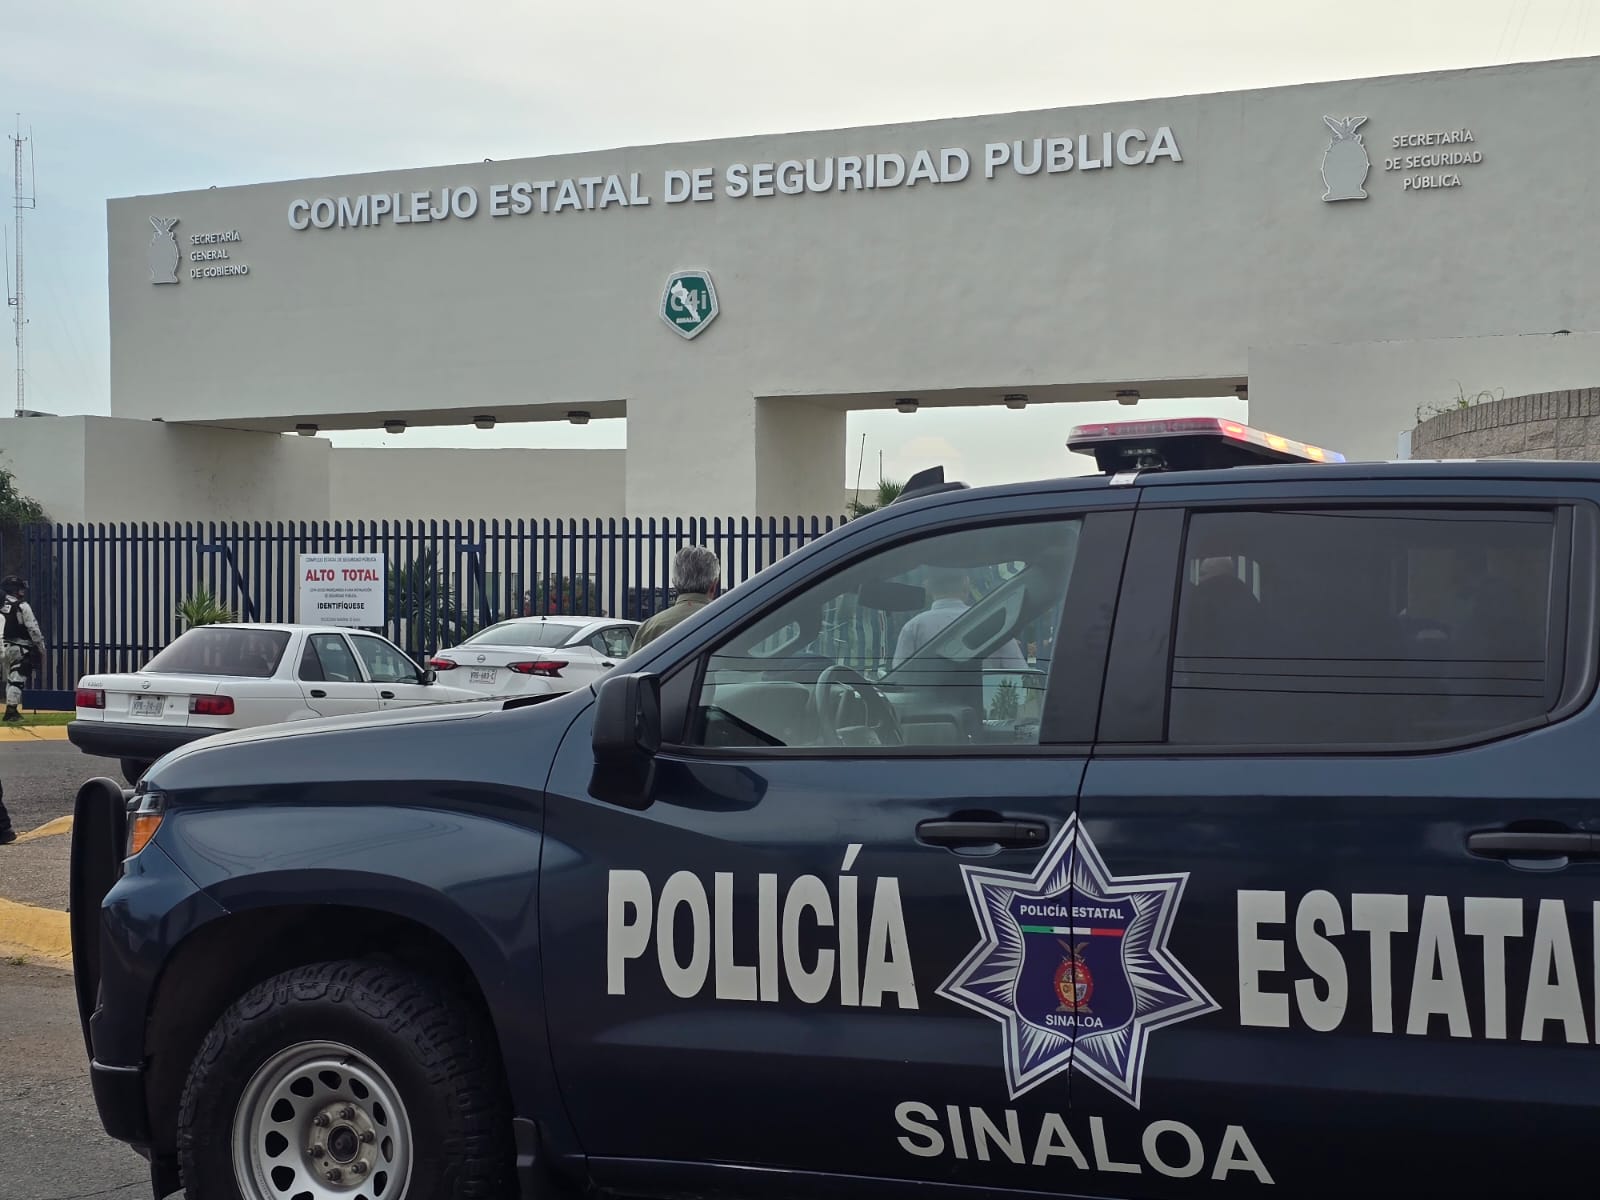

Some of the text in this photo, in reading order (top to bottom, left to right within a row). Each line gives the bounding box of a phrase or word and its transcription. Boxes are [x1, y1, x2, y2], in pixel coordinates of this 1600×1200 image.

[1392, 127, 1475, 148] SECRETARÍA
[1384, 151, 1483, 171] DE SEGURIDAD
[287, 126, 1182, 230] COMPLEJO ESTATAL DE SEGURIDAD PUBLICA
[1403, 173, 1462, 191] PÚBLICA
[190, 230, 242, 245] SECRETARÍA
[190, 249, 230, 262] GENERAL
[190, 264, 249, 279] DE GOBIERNO
[305, 569, 379, 582] ALTO TOTAL
[317, 601, 365, 610] IDENTIFÍQUESE
[1020, 903, 1125, 920] POLICÍA ESTATAL
[607, 843, 1600, 1045] POLICÍA ESTATA
[1045, 1014, 1104, 1029] SINALOA
[894, 1101, 1275, 1185] SINALOA
